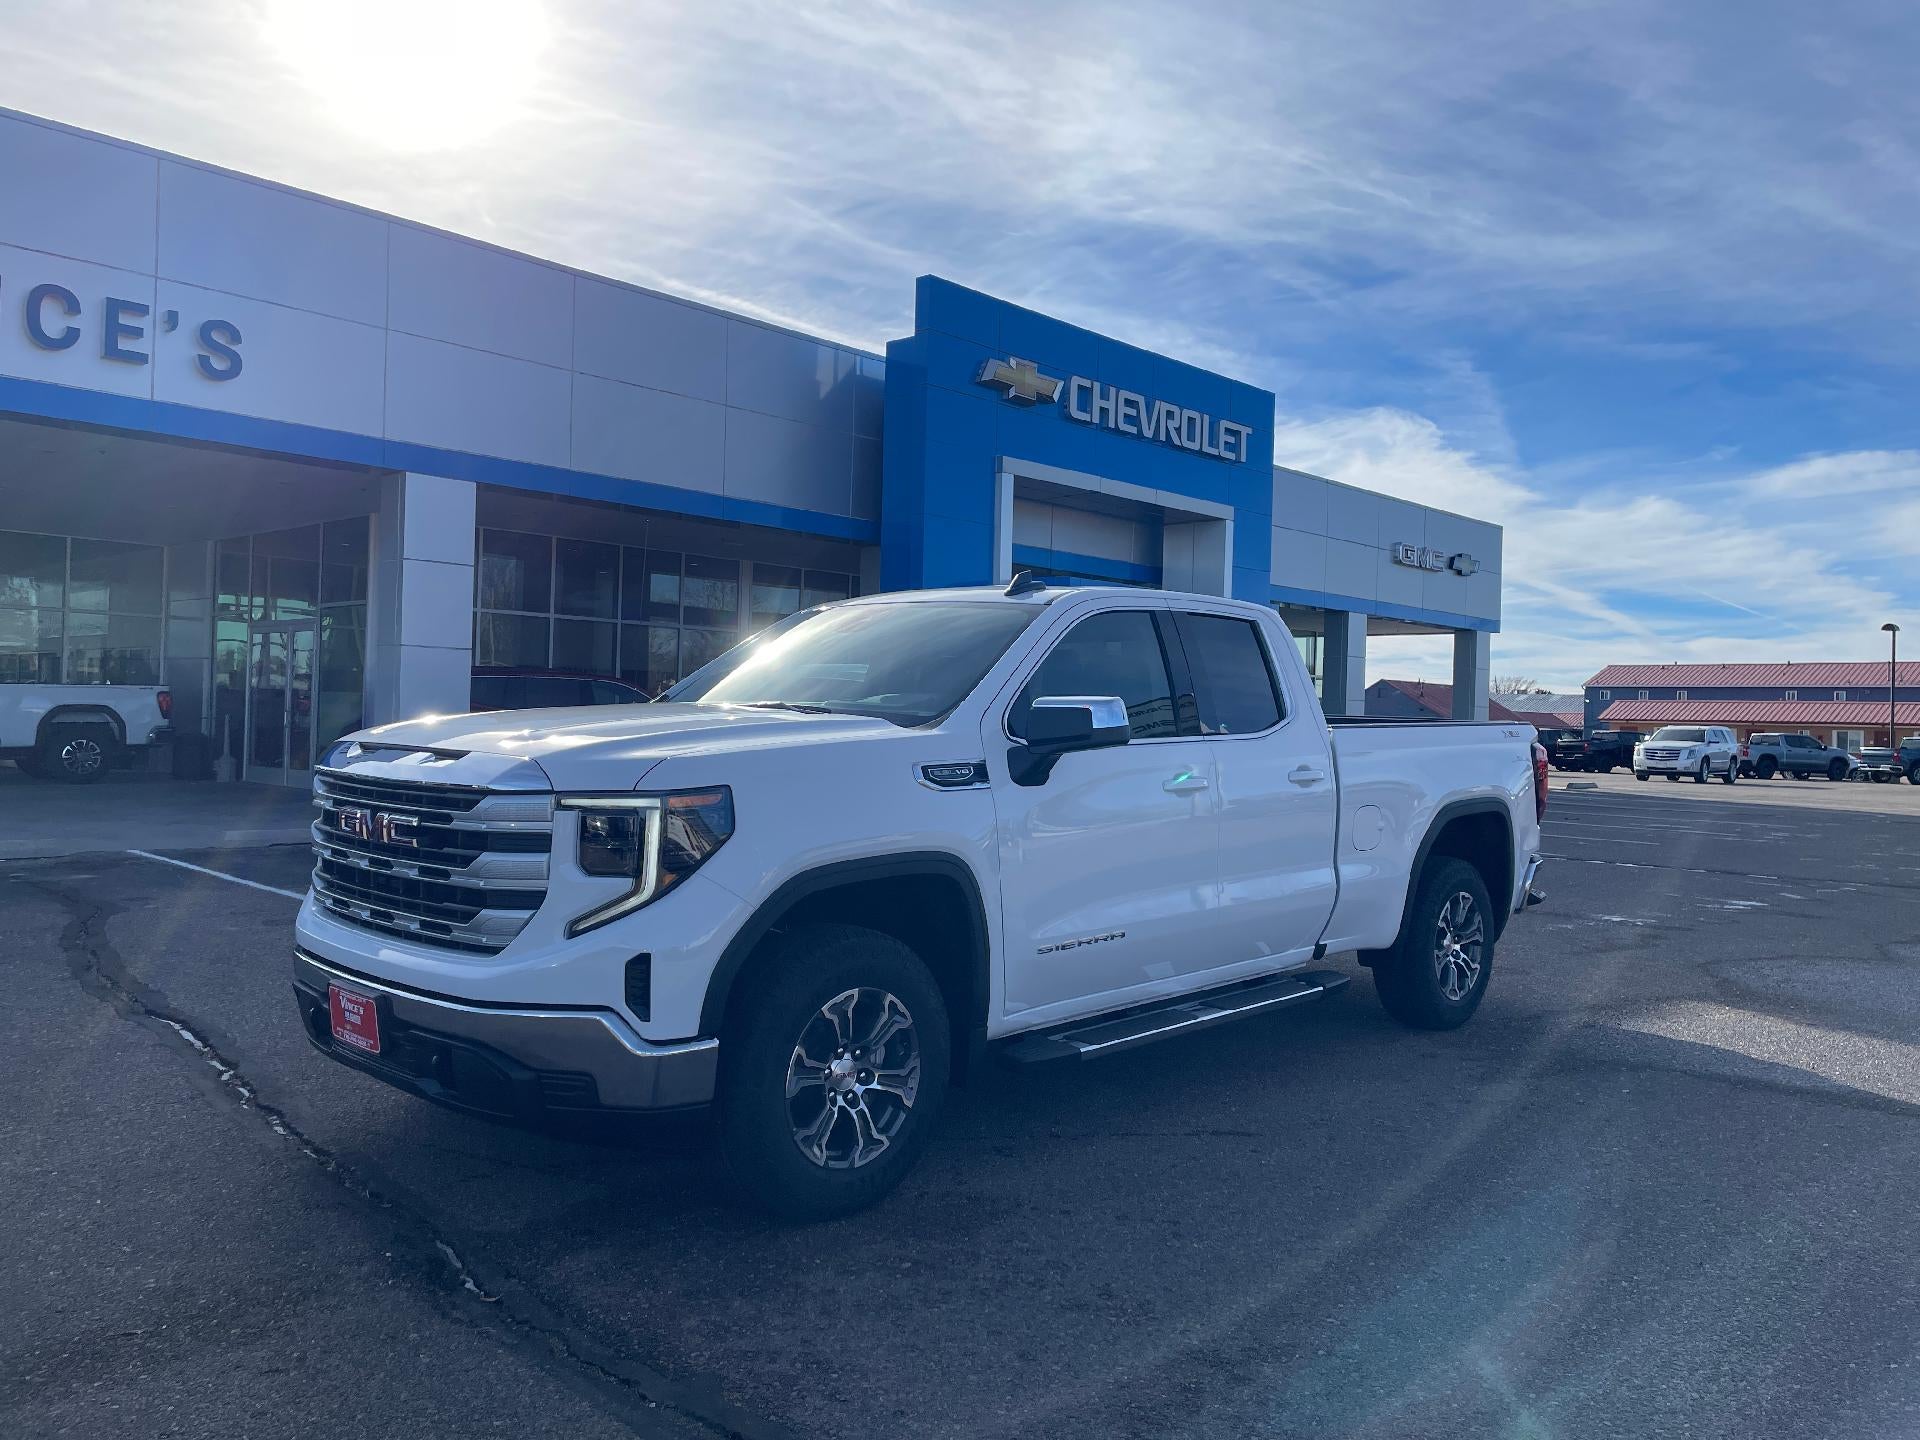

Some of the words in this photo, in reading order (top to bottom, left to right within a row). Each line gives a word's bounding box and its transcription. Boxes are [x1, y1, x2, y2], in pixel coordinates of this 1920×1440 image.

[0, 275, 243, 382] CE'S
[1065, 374, 1253, 463] CHEVROLET
[1394, 542, 1444, 572] GMC
[339, 806, 418, 848] GMC
[1037, 930, 1126, 955] SIERRA
